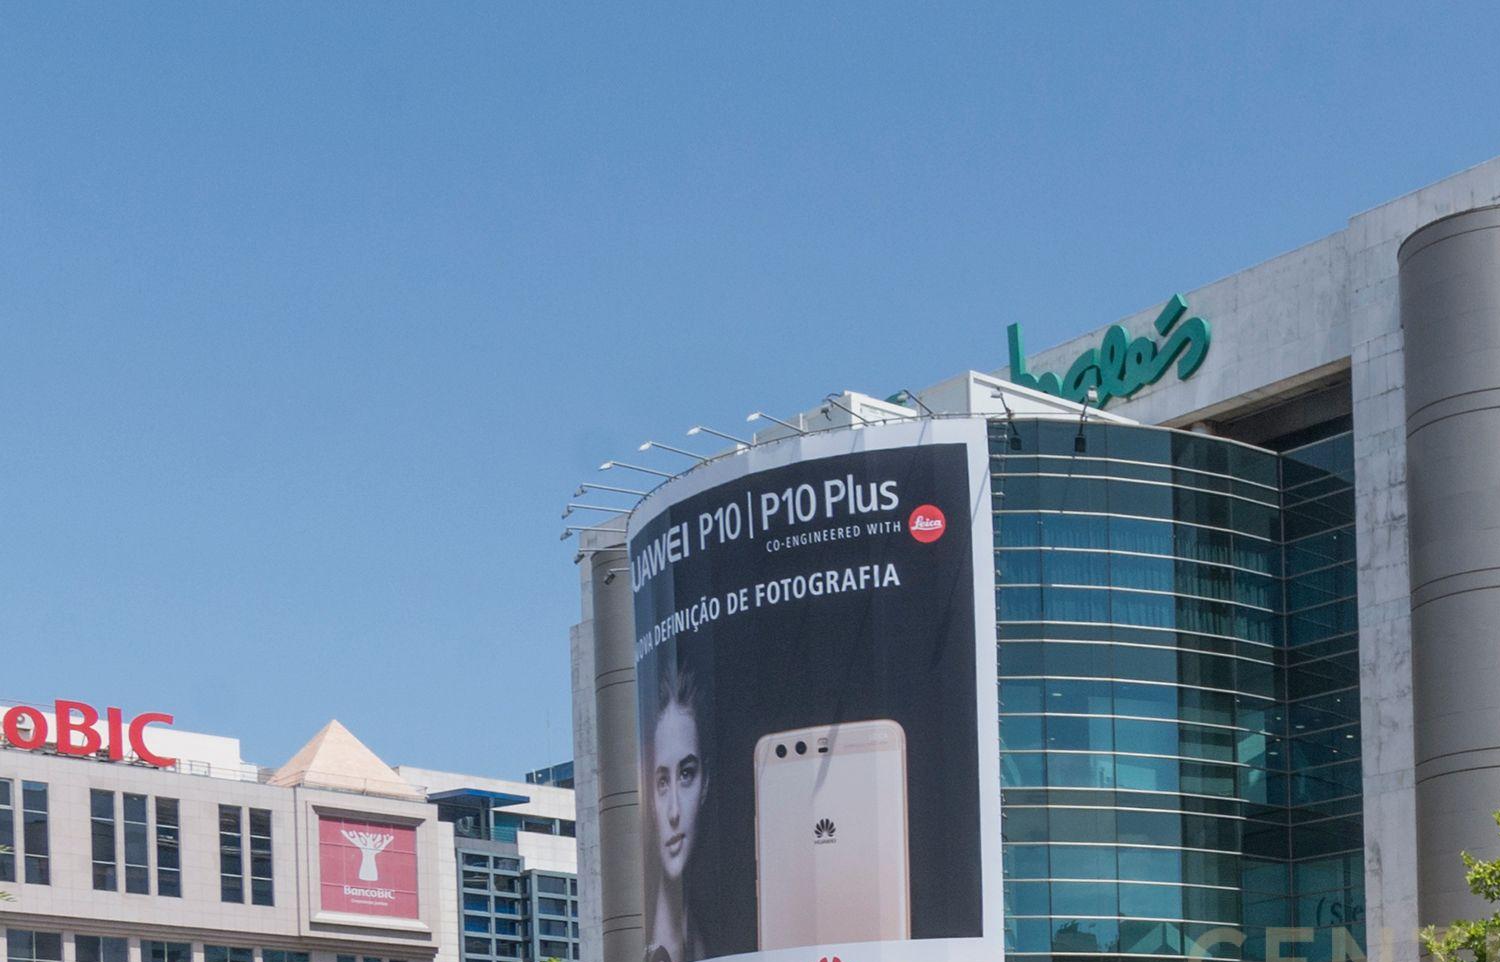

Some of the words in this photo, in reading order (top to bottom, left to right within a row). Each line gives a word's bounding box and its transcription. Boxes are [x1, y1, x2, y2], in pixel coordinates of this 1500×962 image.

[698, 502, 741, 551] P10
[760, 483, 817, 531] P10
[824, 474, 899, 518] Plus
[766, 525, 861, 553] CO-ENGINEERED
[866, 521, 901, 536] WITH
[911, 515, 943, 531] Leica
[654, 596, 720, 646] DEFINIÇÃO
[727, 588, 749, 615] DE
[755, 563, 901, 607] FOTOGRAFIA
